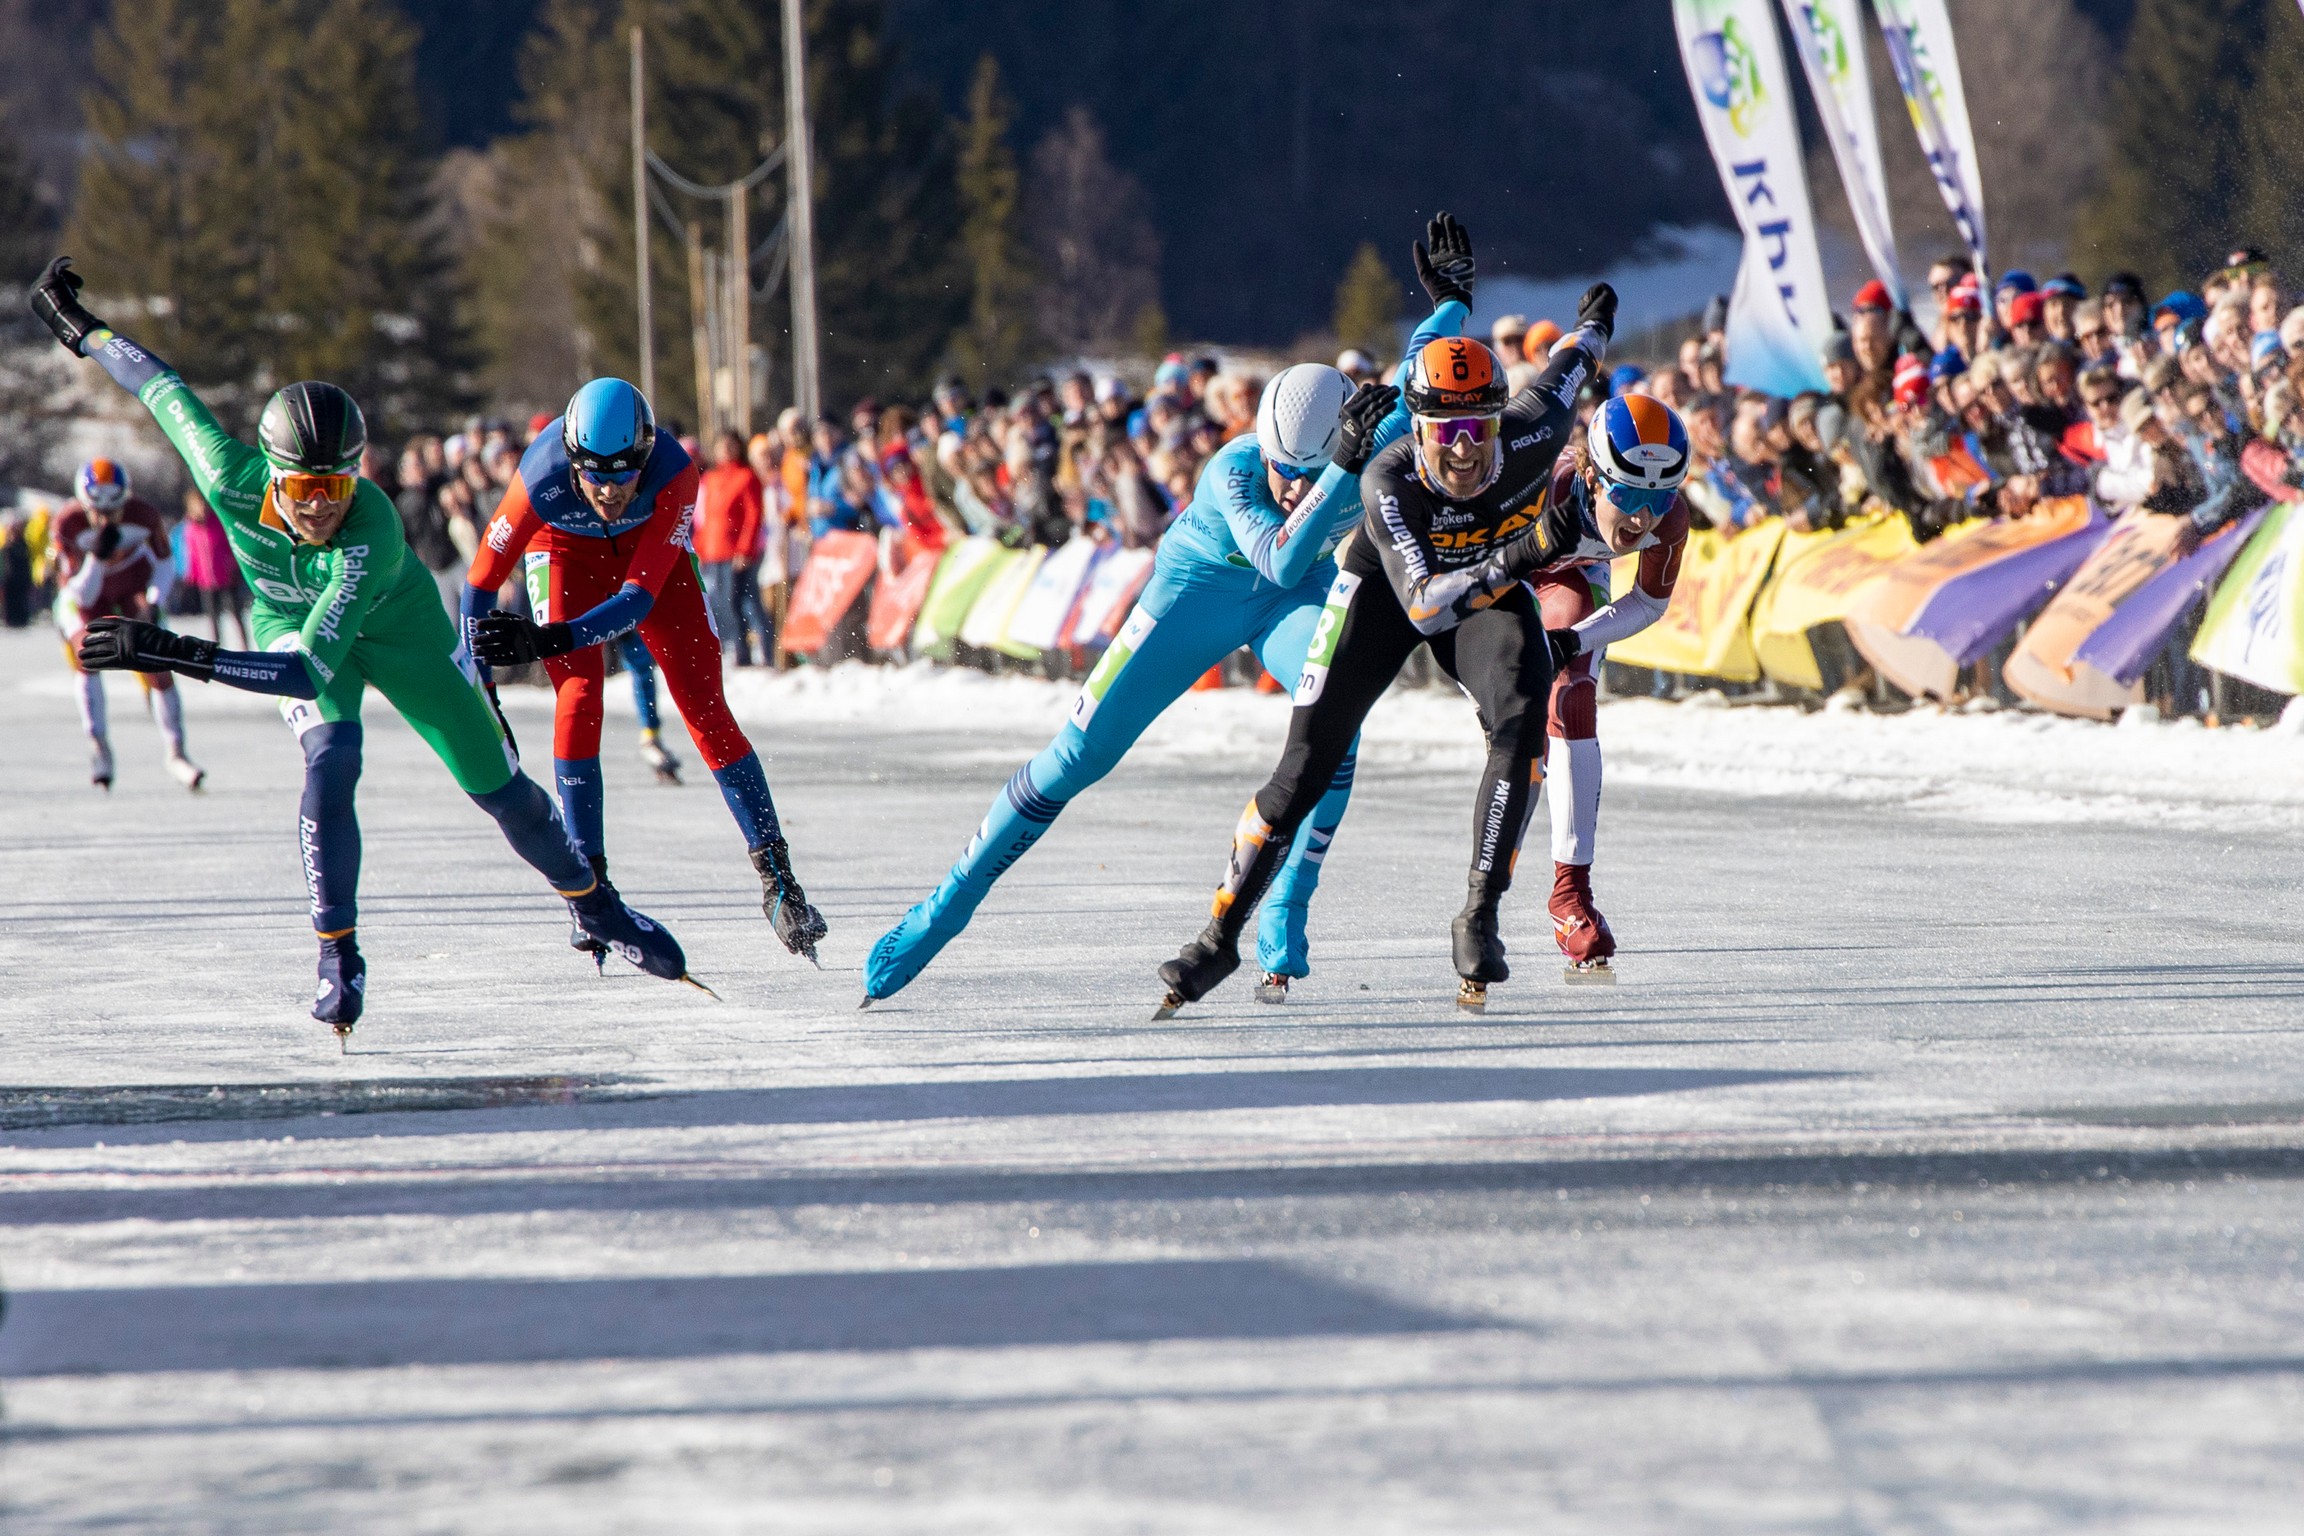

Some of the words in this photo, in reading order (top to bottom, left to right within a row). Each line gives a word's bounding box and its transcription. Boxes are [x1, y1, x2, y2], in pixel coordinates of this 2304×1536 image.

[103, 343, 123, 361] TECH
[110, 338, 147, 363] AERES
[1441, 393, 1483, 404] OKAY
[166, 399, 186, 424] De
[181, 420, 222, 484] Friesland
[1510, 431, 1541, 451] AGU
[540, 485, 566, 502] RBL
[670, 504, 696, 548] KPMS
[1287, 491, 1328, 535] WORKWEAR
[1432, 512, 1476, 527] brokers
[233, 521, 278, 549] HUNTER
[490, 521, 513, 554] KPMS
[1379, 494, 1430, 589] nterfarms
[315, 544, 370, 643] Rabobank
[213, 663, 278, 681] ADRENNA
[558, 775, 587, 786] RBL
[1481, 779, 1511, 862] PAYCOMPANY
[301, 815, 324, 918] Rabobank
